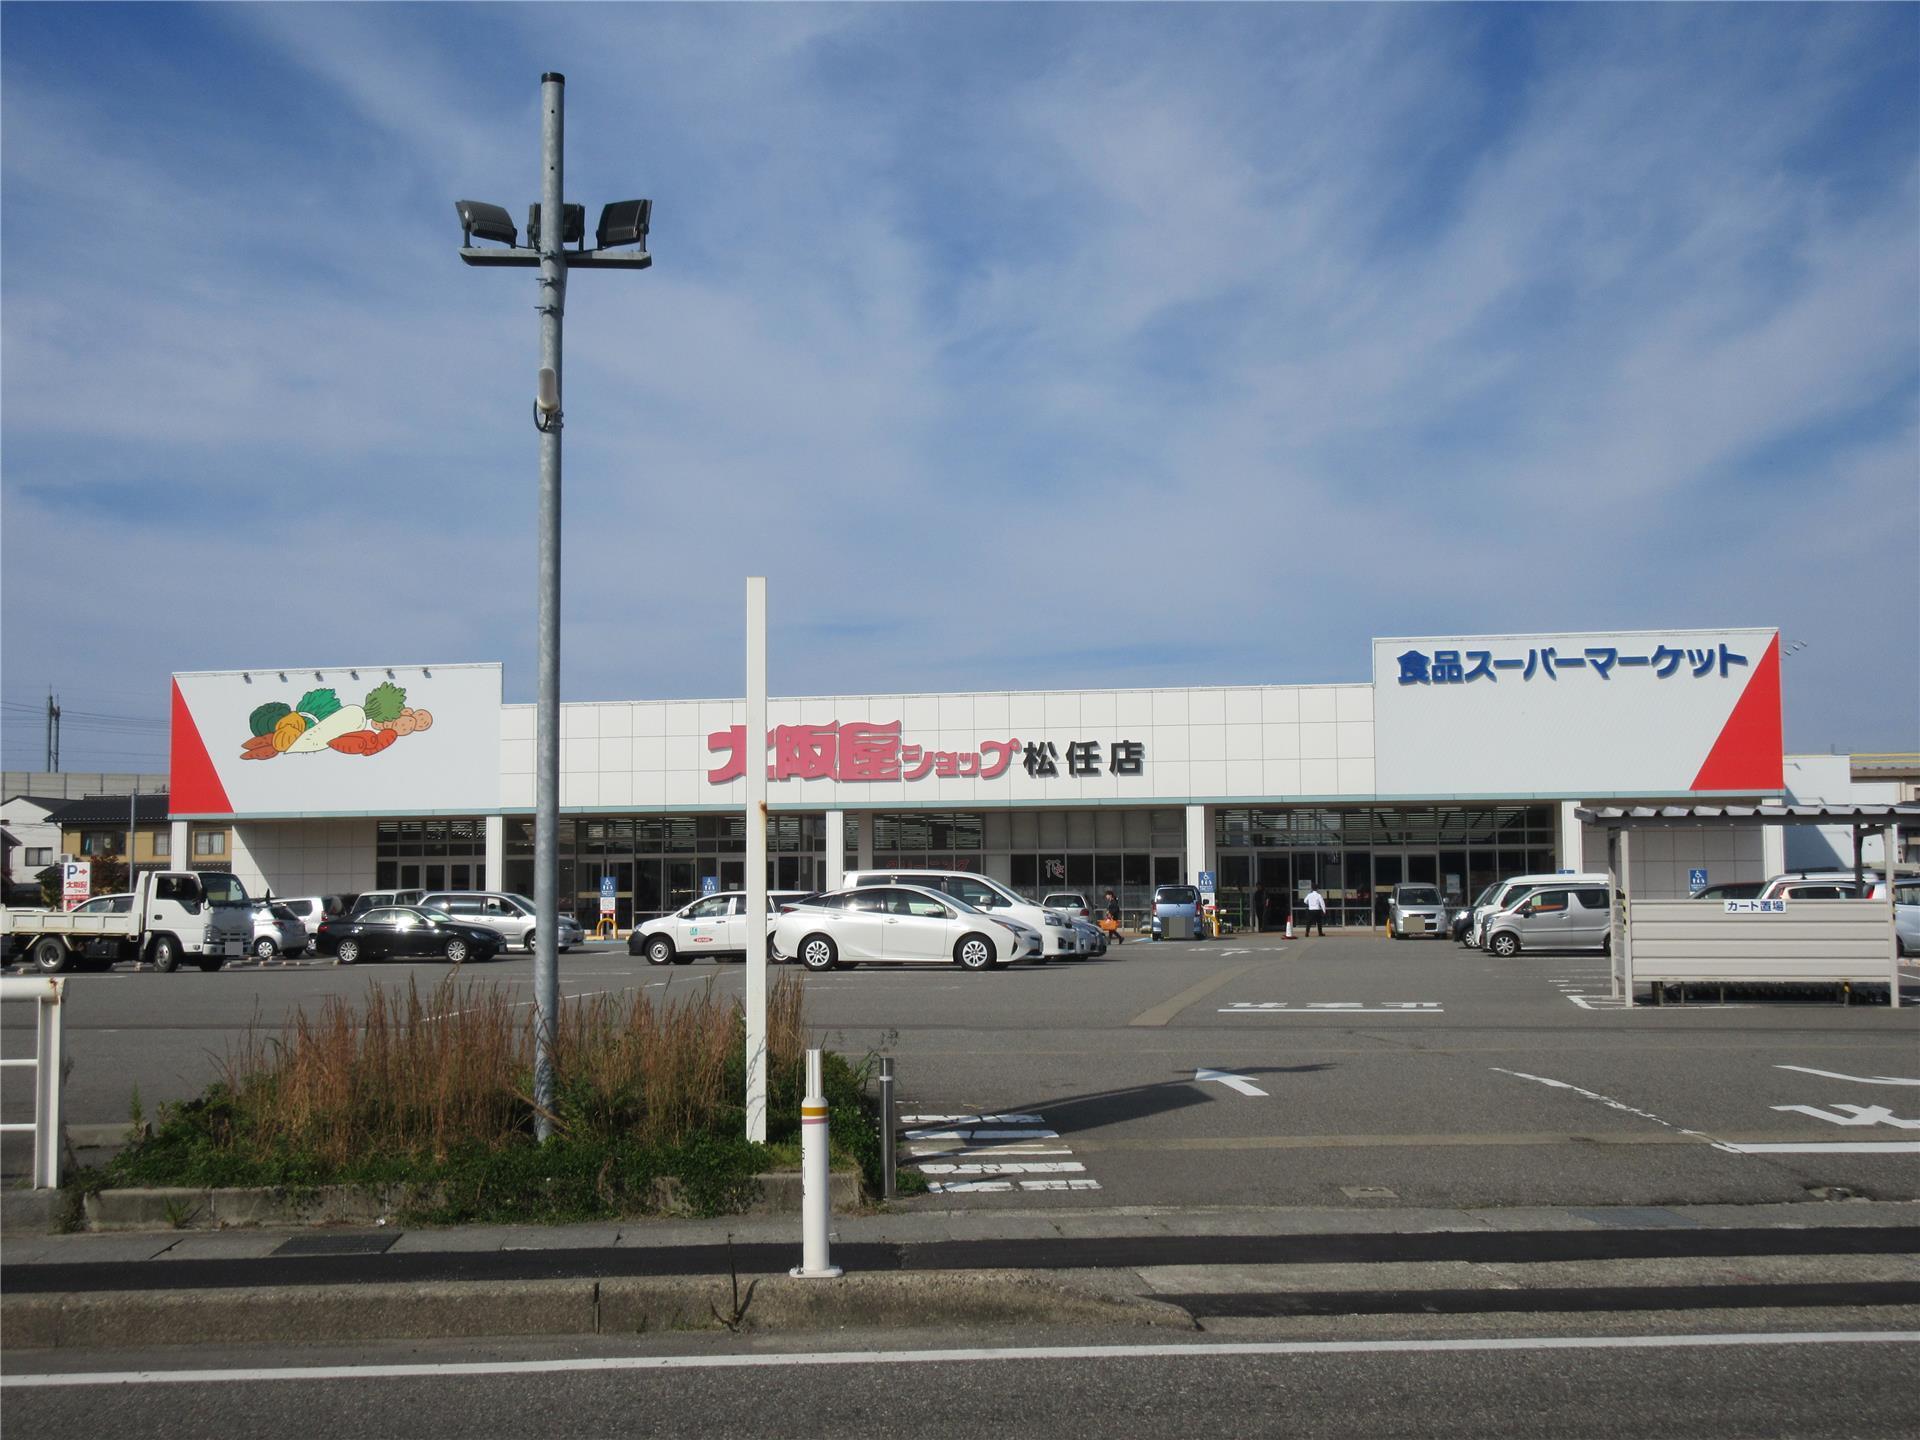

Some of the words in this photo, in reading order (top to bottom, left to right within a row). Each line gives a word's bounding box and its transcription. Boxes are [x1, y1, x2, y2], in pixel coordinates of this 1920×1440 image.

[1396, 643, 1748, 685] 食品スーパーマーケット
[1023, 738, 1143, 777] 松任店
[67, 865, 78, 879] P
[1728, 901, 1783, 911] カート置場
